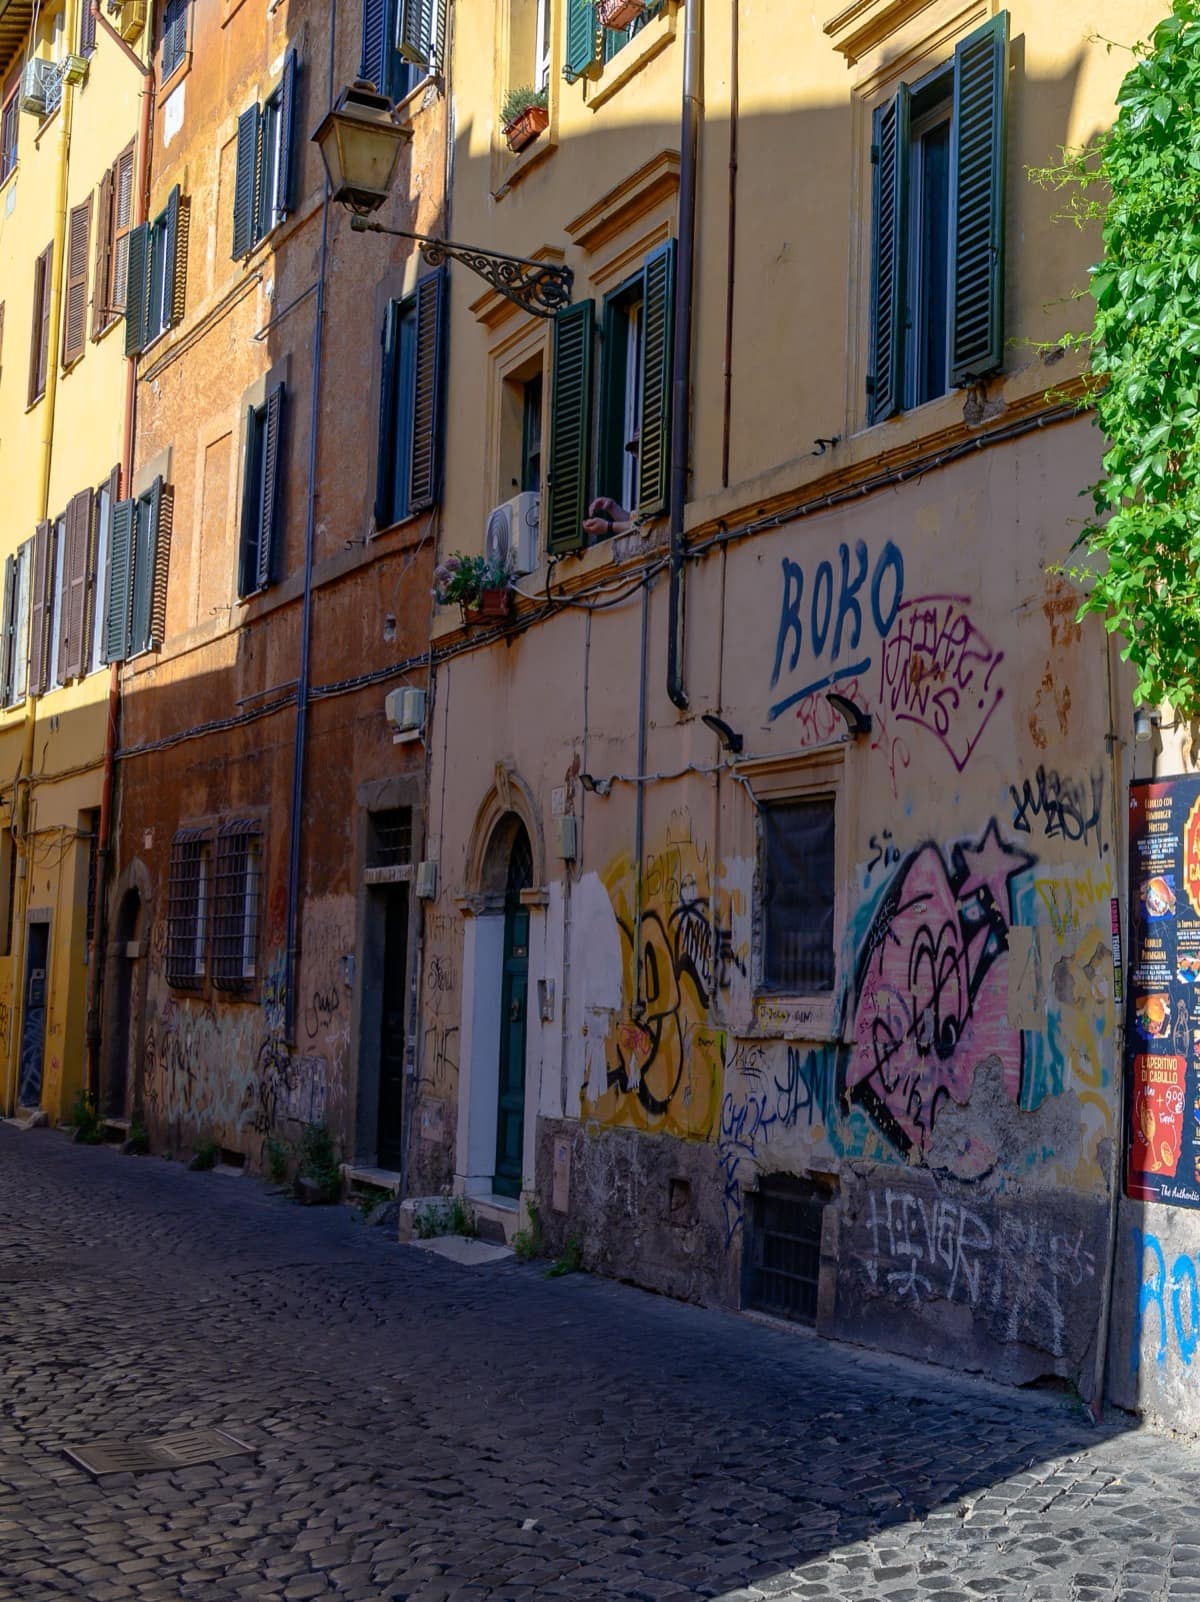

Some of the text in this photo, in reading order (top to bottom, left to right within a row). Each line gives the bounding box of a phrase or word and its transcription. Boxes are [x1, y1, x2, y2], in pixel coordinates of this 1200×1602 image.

[1150, 1071, 1178, 1084] CABULLO
[1161, 1184, 1171, 1197] The
[1172, 1186, 1200, 1202] Authentic
